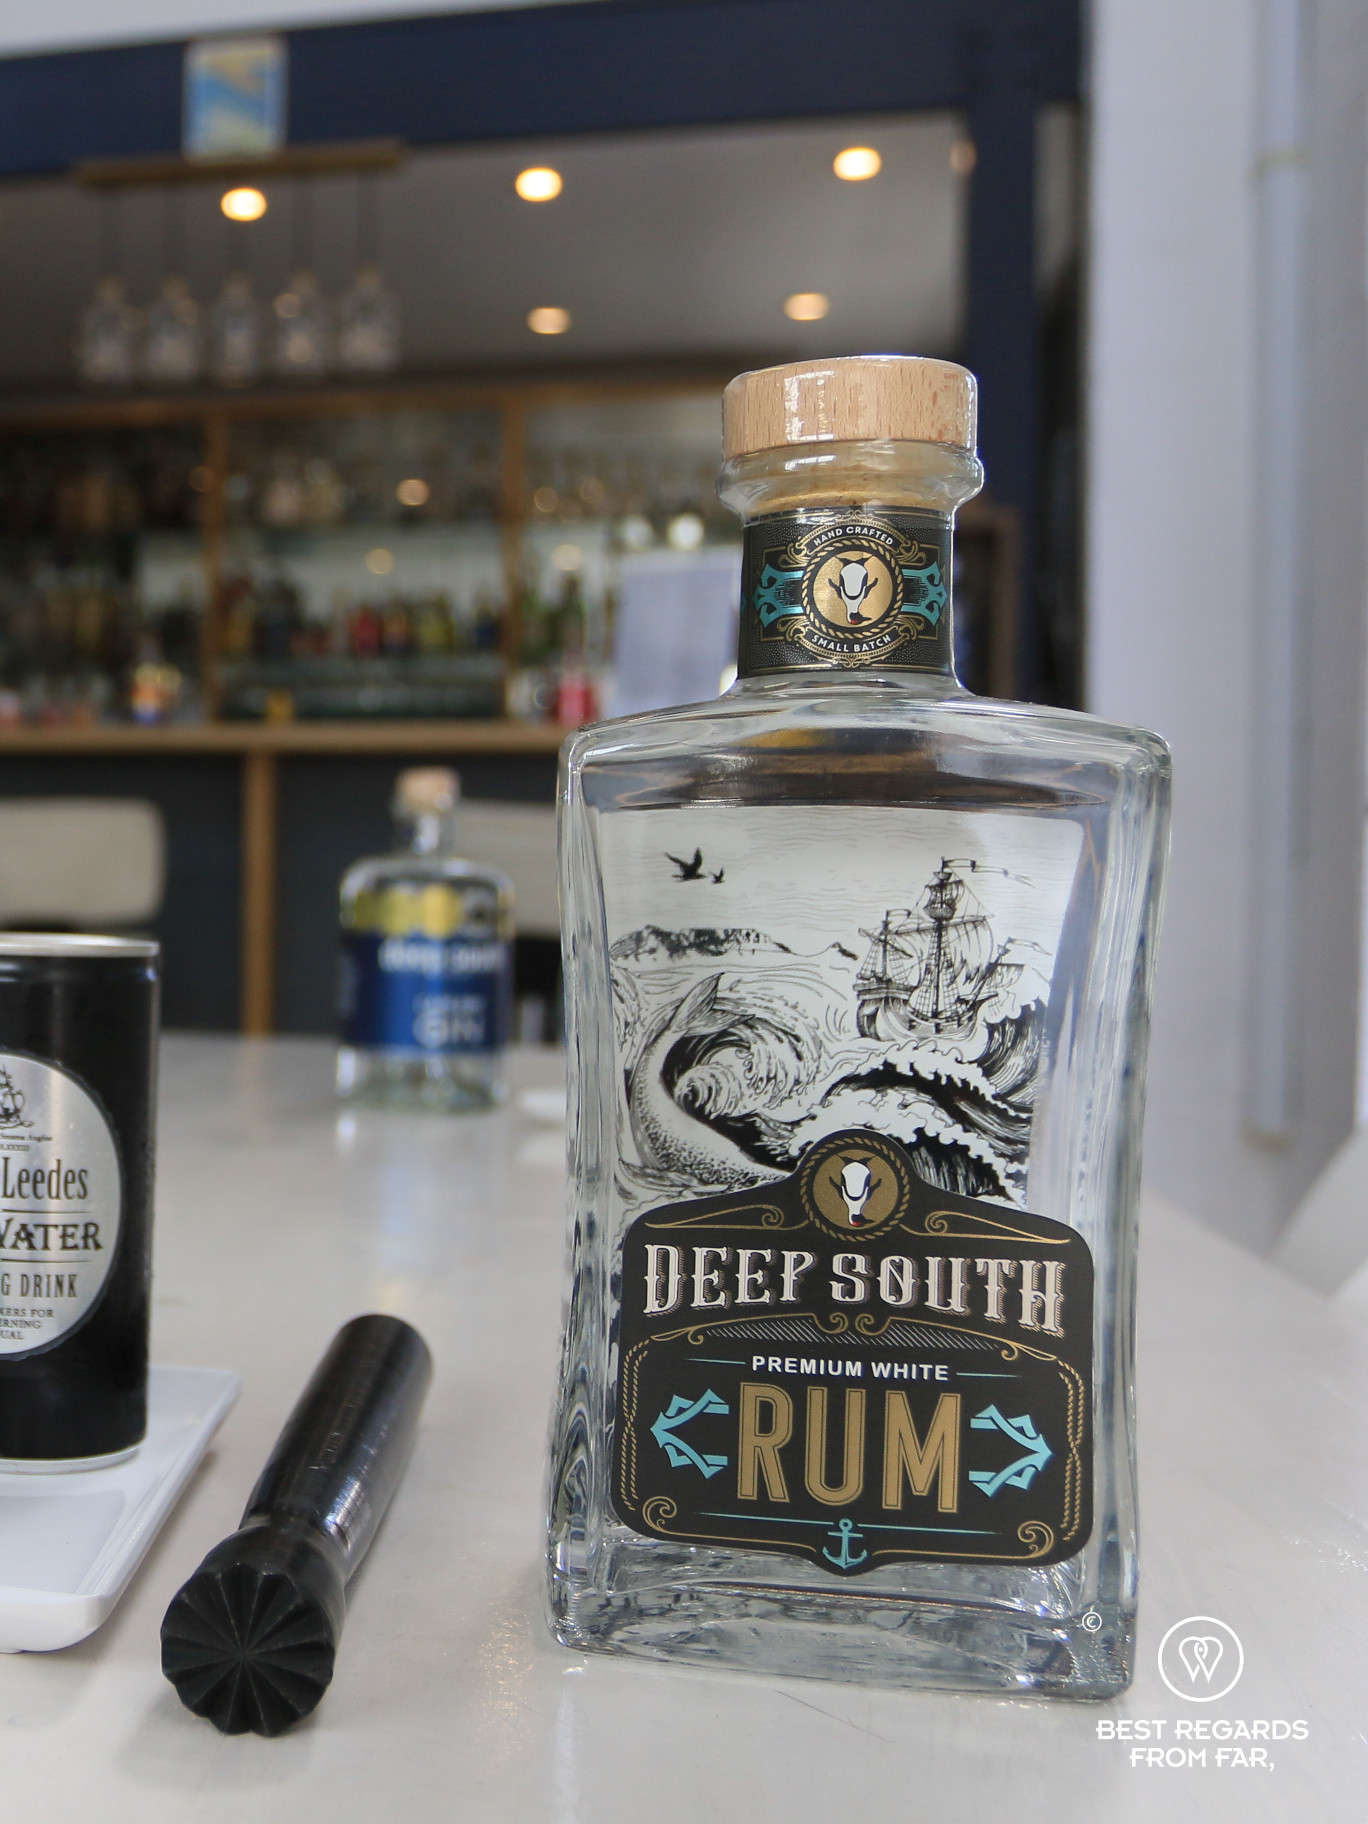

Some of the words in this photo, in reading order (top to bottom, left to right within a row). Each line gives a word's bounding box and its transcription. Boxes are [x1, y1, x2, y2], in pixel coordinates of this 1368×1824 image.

[813, 529, 843, 546] HAND
[846, 526, 894, 546] CRAFTED
[811, 634, 849, 652] SMALL
[853, 634, 892, 652] BATCH
[1, 1156, 89, 1200] Leedes
[20, 1272, 79, 1298] DRINK
[643, 1242, 818, 1318] DEEP
[829, 1252, 1068, 1339] SOUTH
[30, 1308, 55, 1319] FOR
[751, 1355, 863, 1378] PREMIUM
[871, 1362, 949, 1382] WHITE
[737, 1382, 962, 1514] RUM
